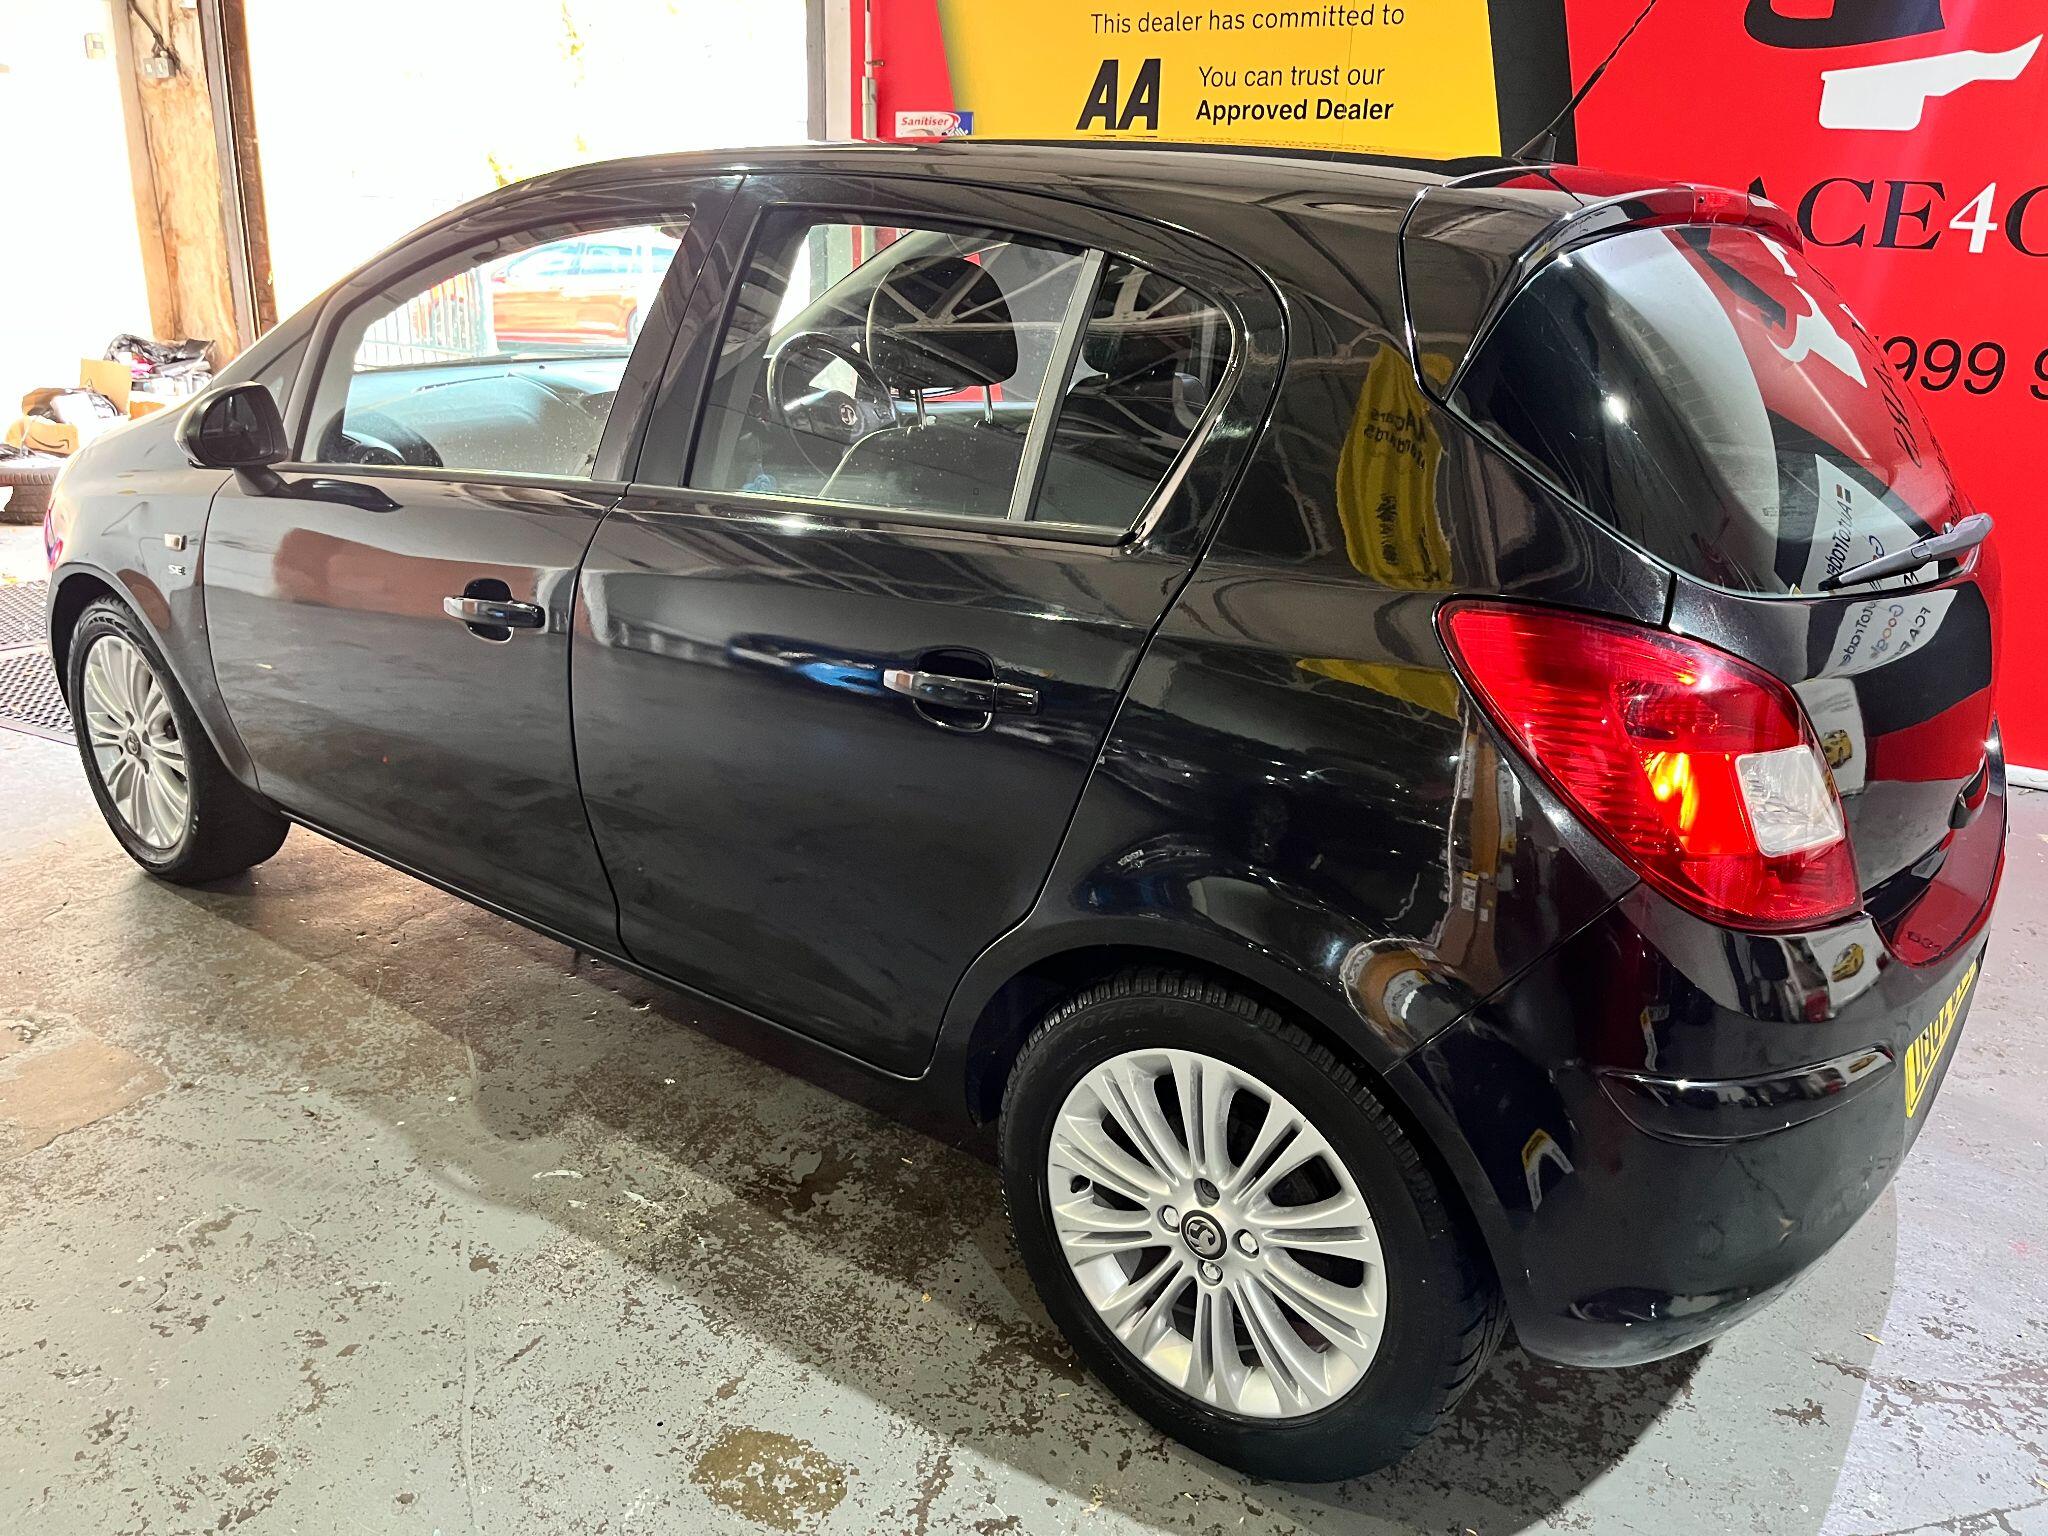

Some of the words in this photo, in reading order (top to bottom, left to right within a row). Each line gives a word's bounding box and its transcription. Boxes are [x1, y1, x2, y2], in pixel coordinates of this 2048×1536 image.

[1091, 13, 1130, 34] This
[1138, 11, 1203, 33] dealer
[1209, 9, 1245, 31] has
[1252, 4, 1375, 29] committed
[1382, 4, 1405, 26] to
[1198, 66, 1237, 88] You
[1244, 70, 1283, 87] can
[1290, 65, 1340, 86] trust
[1347, 68, 1386, 86] our
[1076, 58, 1162, 131] AA
[901, 116, 949, 126] Sanitiser
[1195, 98, 1308, 125] Approved
[1316, 98, 1395, 120] Dealer
[1747, 176, 2048, 257] CE4C
[1876, 335, 2006, 395] 999
